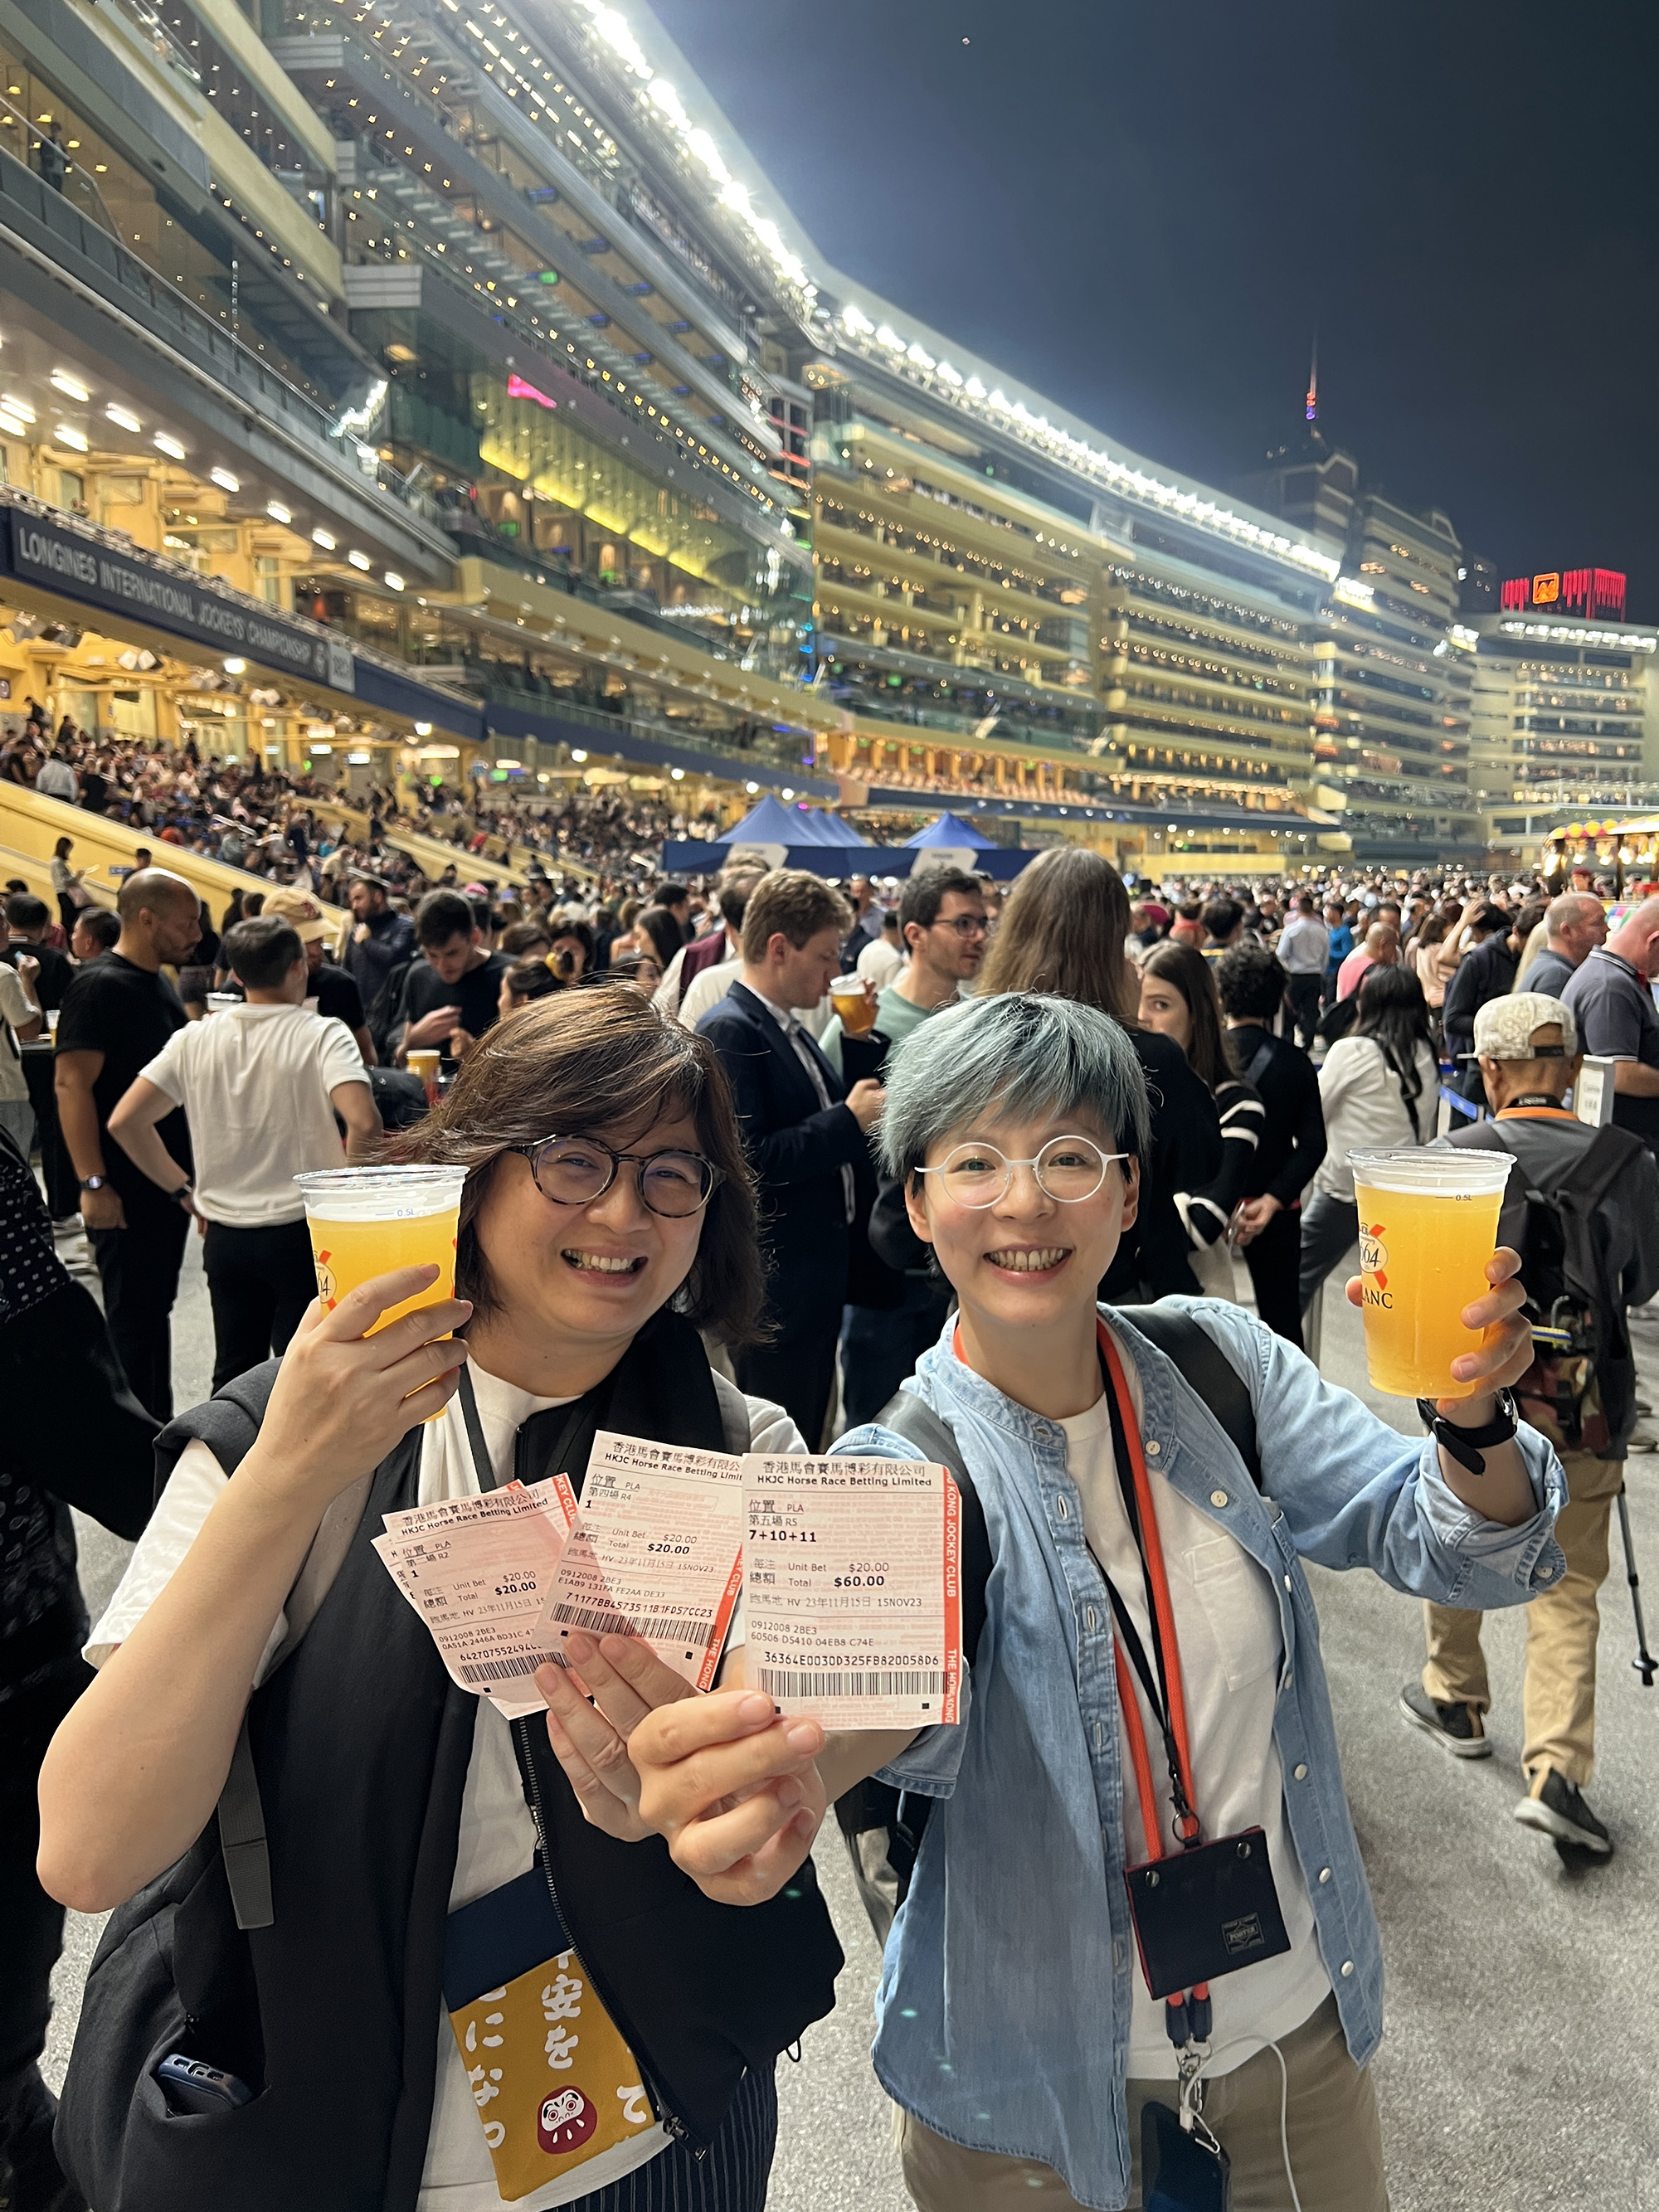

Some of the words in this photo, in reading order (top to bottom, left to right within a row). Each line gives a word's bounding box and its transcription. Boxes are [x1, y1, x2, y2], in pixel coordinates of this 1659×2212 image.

[19, 527, 98, 586] LONGINES
[100, 560, 196, 622] INTERNATIONAL
[613, 1441, 741, 1471] 香港馬會賽馬博彩有限公
[605, 1452, 629, 1464] HKJC
[632, 1458, 659, 1470] Horse
[661, 1464, 683, 1472] Race
[685, 1466, 718, 1479] Betting
[720, 1471, 742, 1481] Limit
[763, 1461, 925, 1477] 香港馬會賽馬博彩有限公司
[591, 1473, 616, 1488] 位置
[625, 1482, 640, 1490] PLA
[757, 1475, 784, 1484] HKJC
[788, 1476, 817, 1485] Horse
[821, 1477, 846, 1485] Race
[850, 1477, 888, 1486] Betting
[893, 1478, 931, 1486] Limited
[585, 1500, 592, 1509] 1
[620, 1493, 631, 1501] R4
[946, 1485, 956, 1516] KONG
[749, 1500, 776, 1514] 位置
[787, 1504, 804, 1513] PLA
[401, 1525, 425, 1536] HKJC
[427, 1518, 454, 1529] Horse
[457, 1514, 477, 1523] Race
[480, 1508, 511, 1519] Betting
[513, 1498, 547, 1514] Limited
[749, 1514, 782, 1526] 第五場
[786, 1518, 797, 1527] R5
[612, 1529, 629, 1538] Unit
[632, 1531, 646, 1539] Bet
[663, 1534, 697, 1544] $20.00
[749, 1529, 817, 1543] 7+10+11
[946, 1519, 956, 1563] JOCKEY
[402, 1545, 426, 1558] 位置
[435, 1540, 451, 1549] PLA
[609, 1540, 629, 1548] Total
[647, 1543, 690, 1555] $20.00
[438, 1552, 450, 1561] R2
[602, 1554, 614, 1563] HV
[618, 1556, 674, 1569] 23年11月15日
[678, 1563, 714, 1573] 15NOV23
[411, 1570, 419, 1578] 1
[788, 1563, 808, 1572] Unit
[811, 1563, 827, 1572] Bet
[849, 1562, 890, 1573] $20.00
[453, 1581, 471, 1592] Unit
[474, 1578, 487, 1588] Bet
[503, 1570, 537, 1583] $20.00
[561, 1569, 597, 1582] 0912008
[600, 1575, 621, 1586] 2BE3
[727, 1573, 741, 1597] CLUB
[788, 1578, 812, 1587] Total
[834, 1576, 885, 1589] $60.00
[946, 1566, 956, 1597] CLUB
[458, 1592, 479, 1602] Total
[495, 1581, 537, 1597] $20.00
[558, 1578, 586, 1588] E1AB9
[588, 1583, 613, 1593] 131FA
[616, 1587, 642, 1597] FE2AA
[644, 1590, 665, 1598] DE33
[463, 1608, 474, 1617] HV
[478, 1598, 532, 1614] 23年11月15日
[788, 1598, 800, 1607] HV
[805, 1597, 871, 1608] 23年11月15日
[878, 1597, 922, 1607] 15NOV23
[439, 1630, 474, 1643] 0912008
[476, 1626, 496, 1636] 2BE3
[752, 1620, 791, 1632] 0912008
[794, 1624, 818, 1635] 2BE3
[470, 1636, 496, 1646] 2446A
[497, 1631, 524, 1641] BD31C
[751, 1632, 779, 1643] 60506
[782, 1636, 813, 1646] D5410
[815, 1637, 847, 1647] 04EB8
[849, 1638, 875, 1647] C74E
[708, 1638, 721, 1658] THE
[764, 1651, 939, 1667] 36364E0030D325FB820058D6
[947, 1649, 957, 1670] THE
[698, 1659, 715, 1689] HONG
[542, 1954, 583, 2069] 安を
